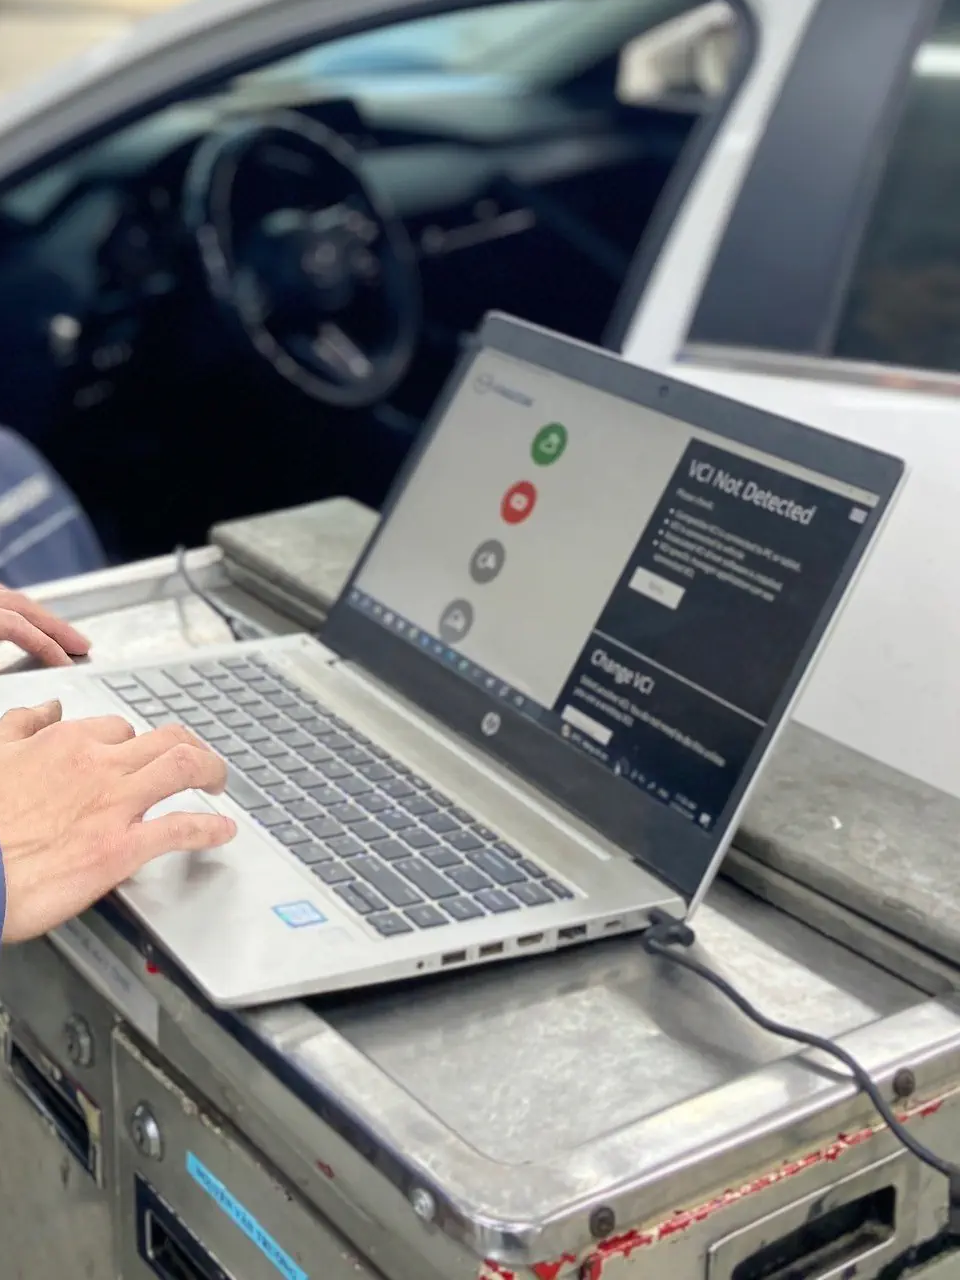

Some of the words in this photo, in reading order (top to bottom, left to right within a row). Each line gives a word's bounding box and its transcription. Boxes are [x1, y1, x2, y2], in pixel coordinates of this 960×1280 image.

[689, 459, 715, 483] VCI
[712, 469, 744, 497] Not
[741, 480, 818, 526] Detected
